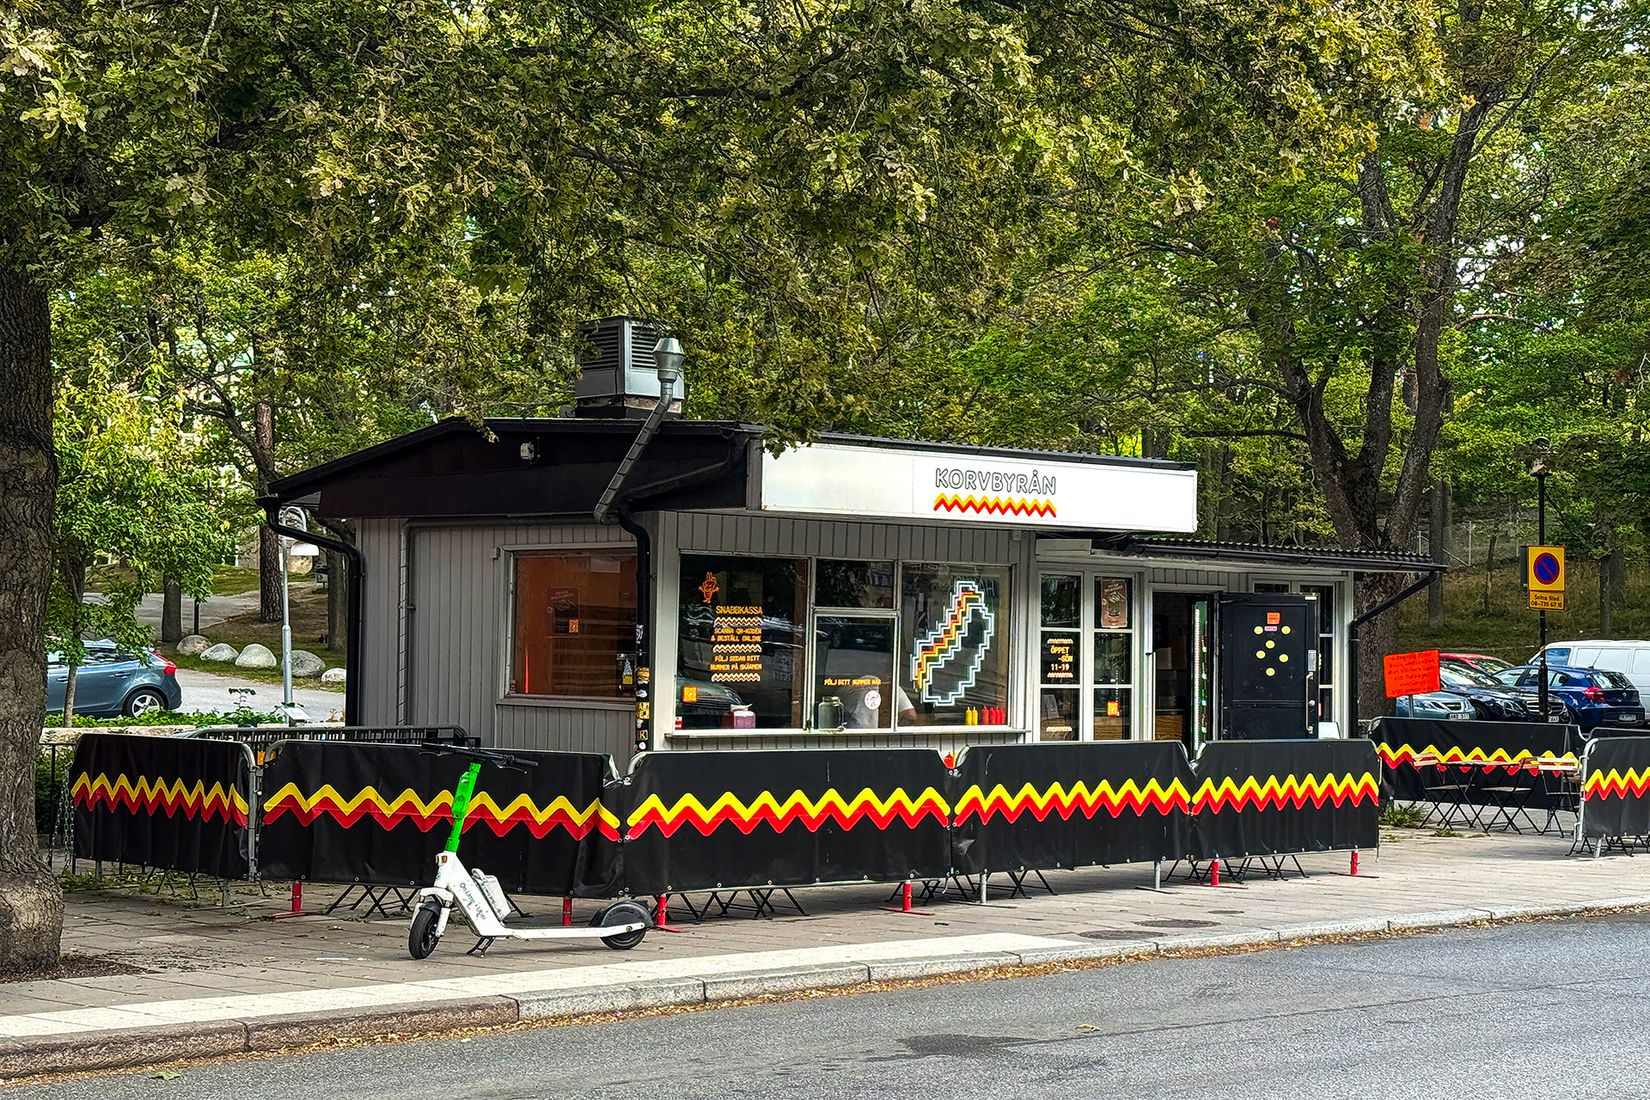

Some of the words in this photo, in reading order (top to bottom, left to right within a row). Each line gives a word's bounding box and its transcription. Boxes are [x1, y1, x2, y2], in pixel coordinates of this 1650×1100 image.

[935, 468, 1057, 495] KORVBYRÅN
[715, 605, 763, 615] SNABBKASSA
[1050, 663, 1070, 671] 11-19
